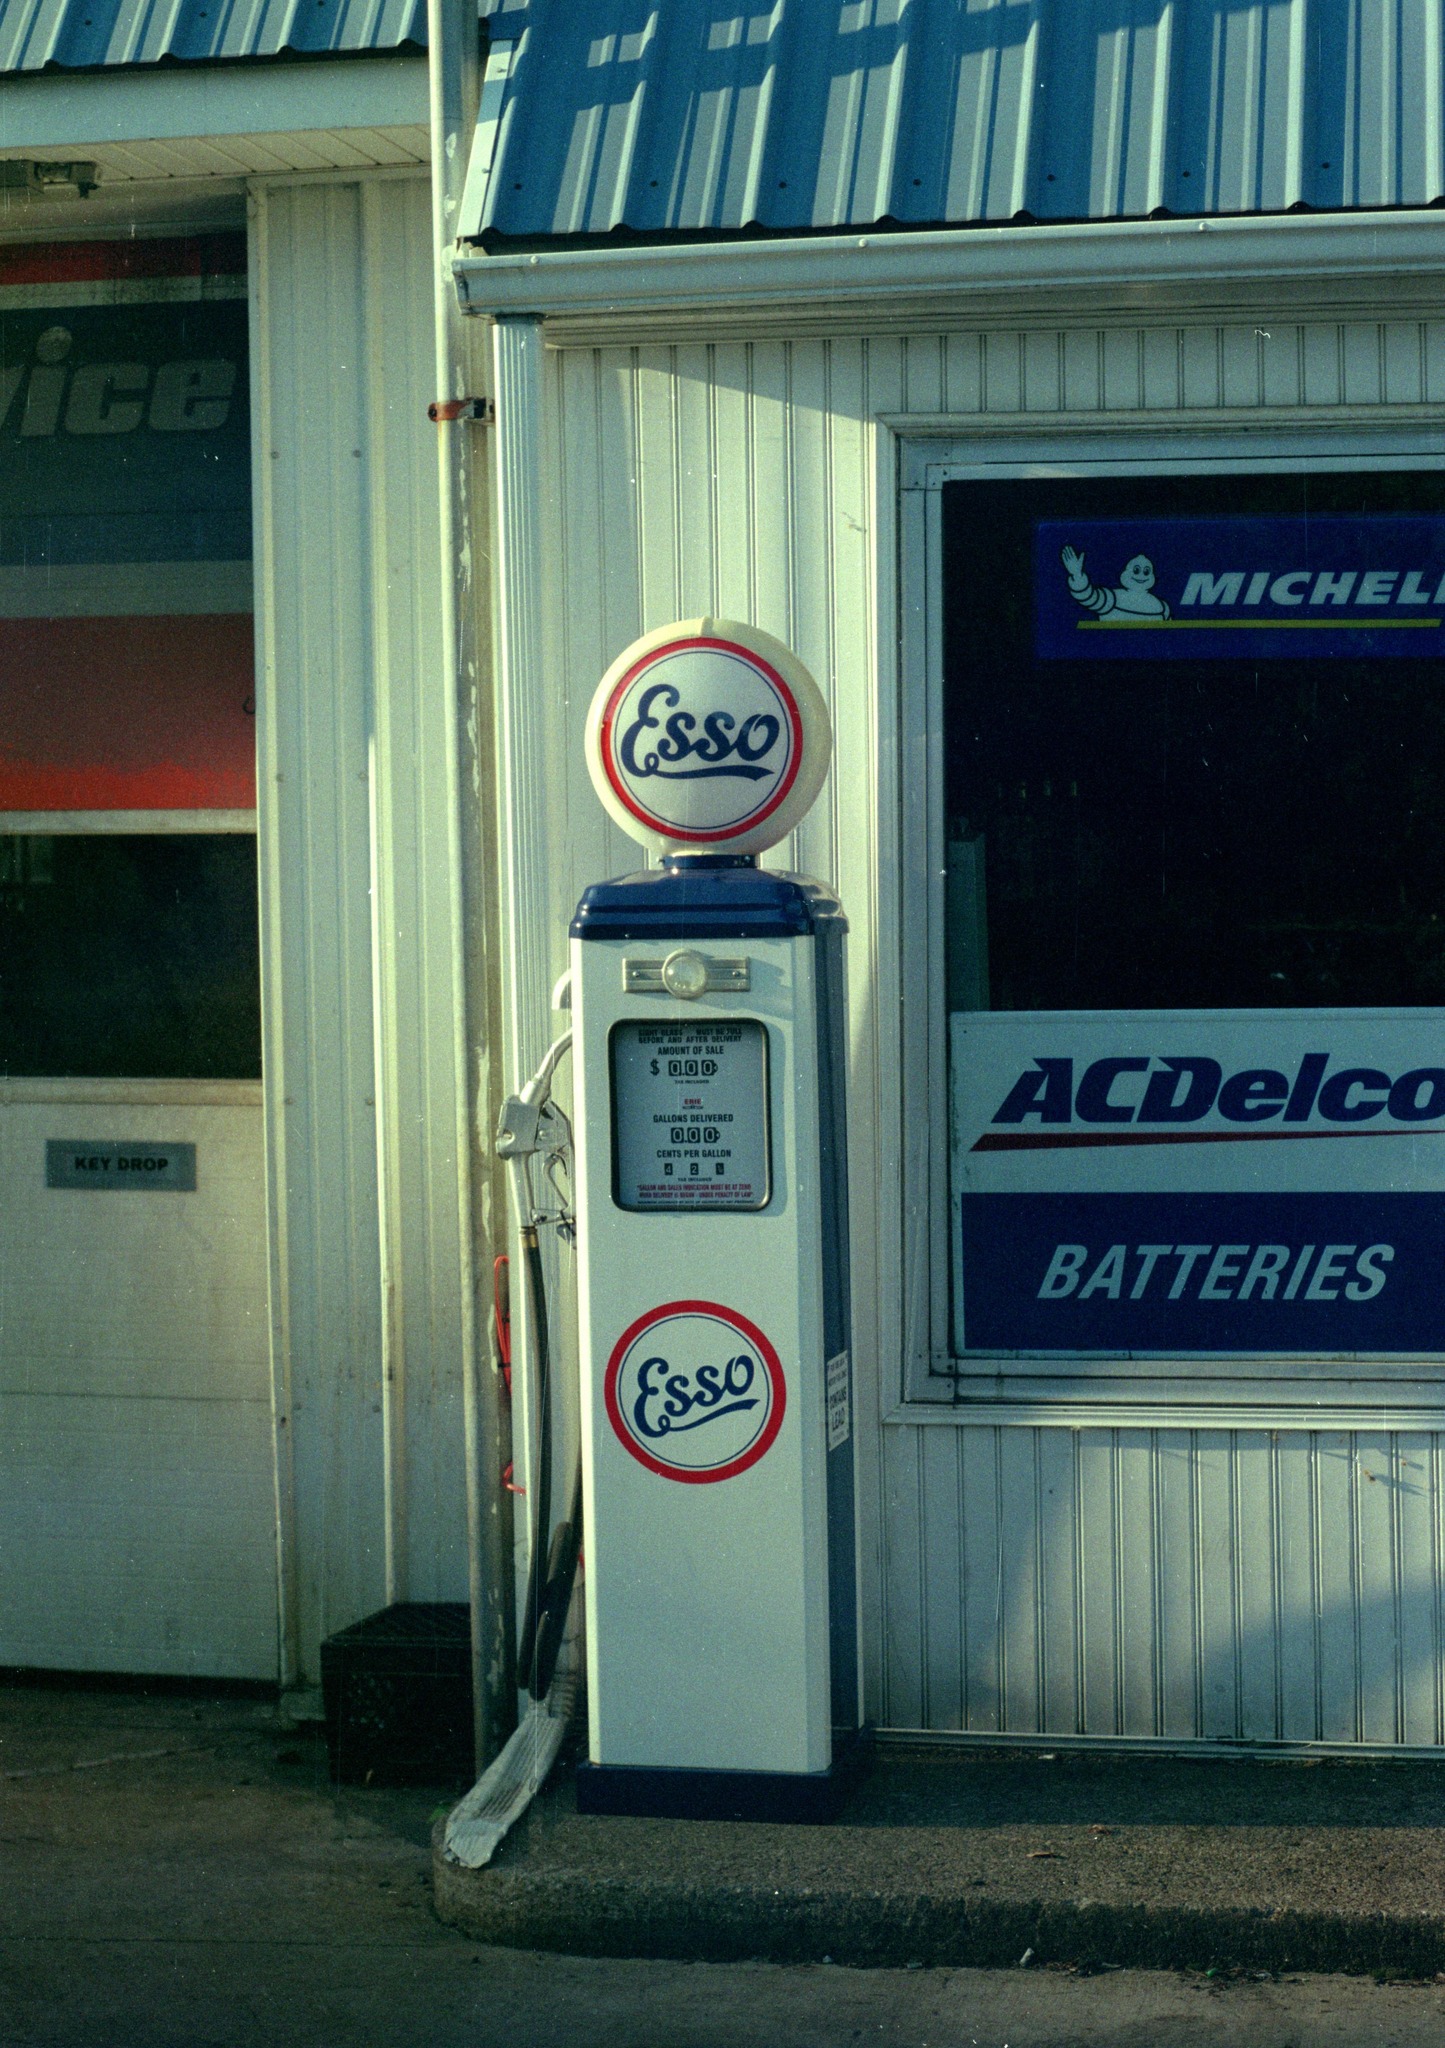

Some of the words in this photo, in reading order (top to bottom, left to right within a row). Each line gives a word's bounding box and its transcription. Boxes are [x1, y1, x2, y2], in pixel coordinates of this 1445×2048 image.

[0, 326, 236, 436] ice
[639, 1036, 664, 1044] BEFORE
[658, 1046, 690, 1055] AMOUNT
[693, 1046, 702, 1054] OF
[705, 1045, 724, 1054] SALE
[650, 1059, 660, 1076] $
[991, 1053, 1445, 1124] ACDelco
[653, 1114, 687, 1123] GALLONS
[690, 1114, 733, 1122] DELIVERED
[656, 1149, 681, 1158] CENTS
[684, 1149, 699, 1157] PER
[702, 1149, 731, 1157] GALLON
[75, 1156, 111, 1171] KEY
[117, 1156, 169, 1171] DROP
[1037, 1244, 1395, 1301] BATTERIES
